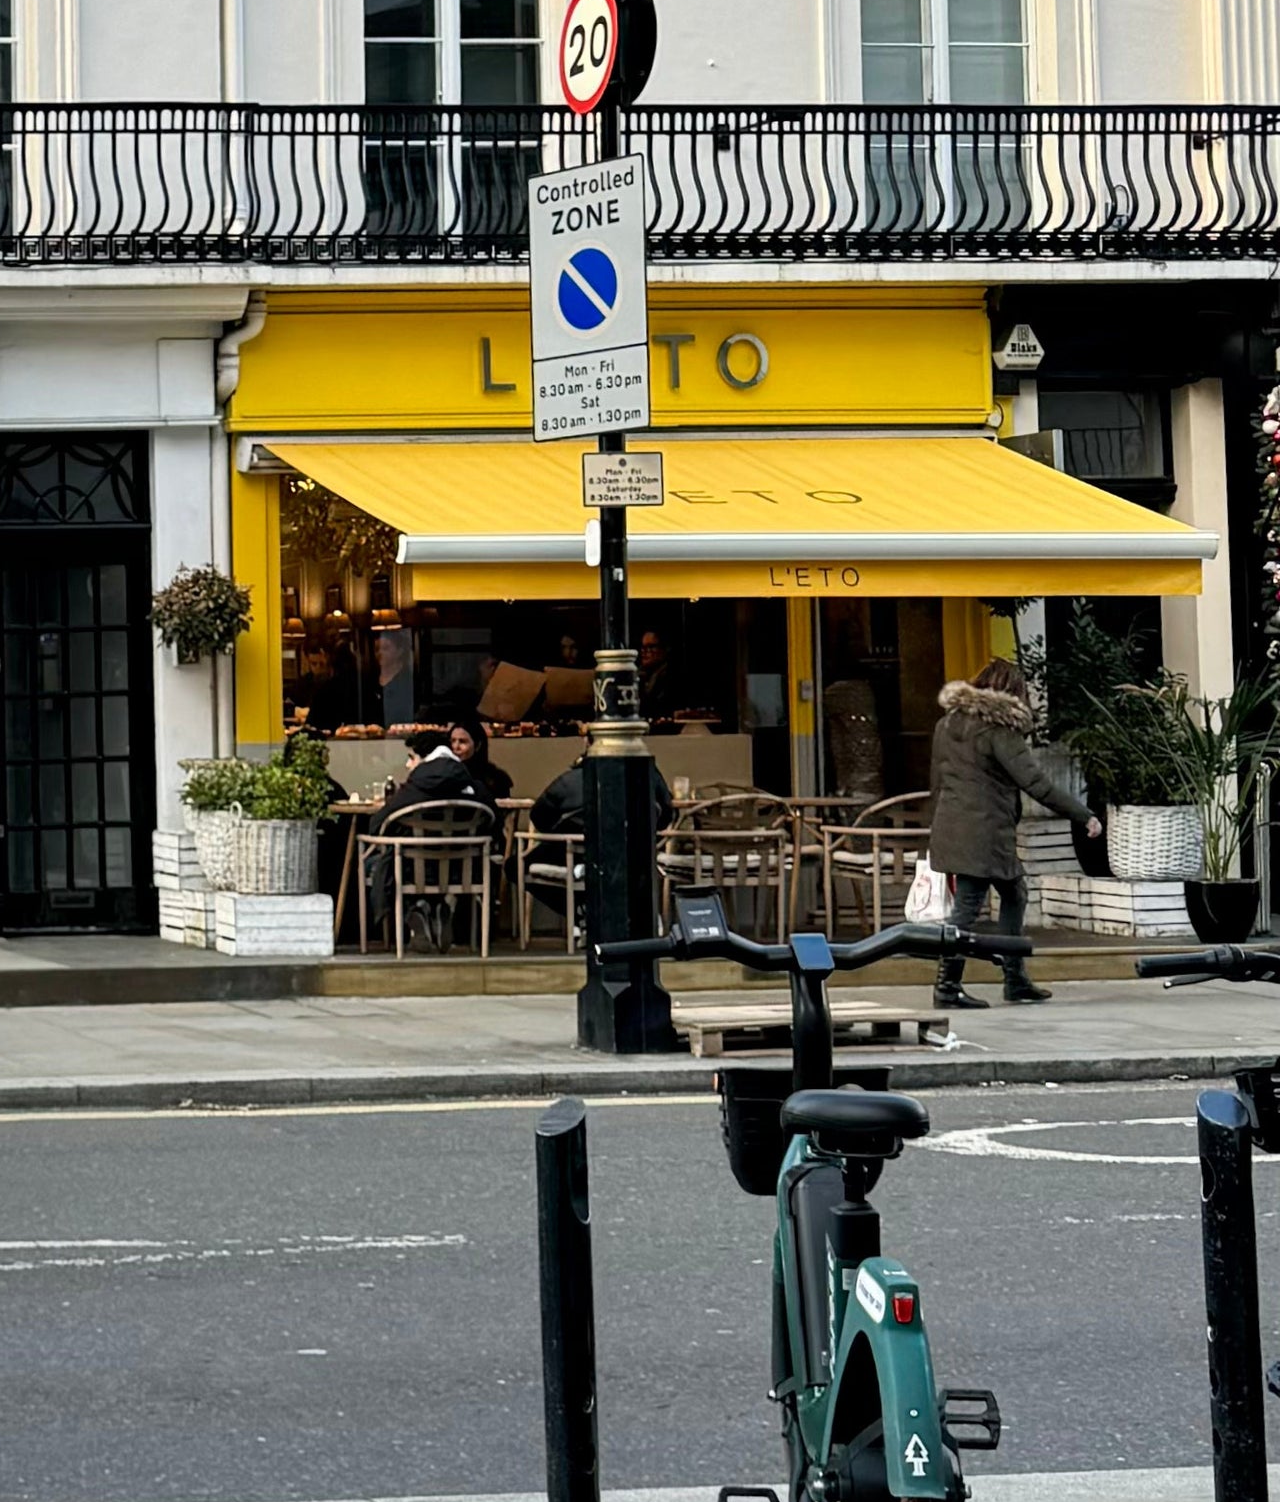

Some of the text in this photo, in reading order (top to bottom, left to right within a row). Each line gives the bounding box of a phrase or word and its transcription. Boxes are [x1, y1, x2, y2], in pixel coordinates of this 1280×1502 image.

[569, 15, 609, 78] 20
[536, 164, 635, 205] Controlled
[551, 198, 621, 236] ZONE
[564, 365, 588, 378] Mon
[599, 358, 615, 373] Fri
[580, 395, 600, 409] Sat
[769, 565, 861, 588] L'ETO
